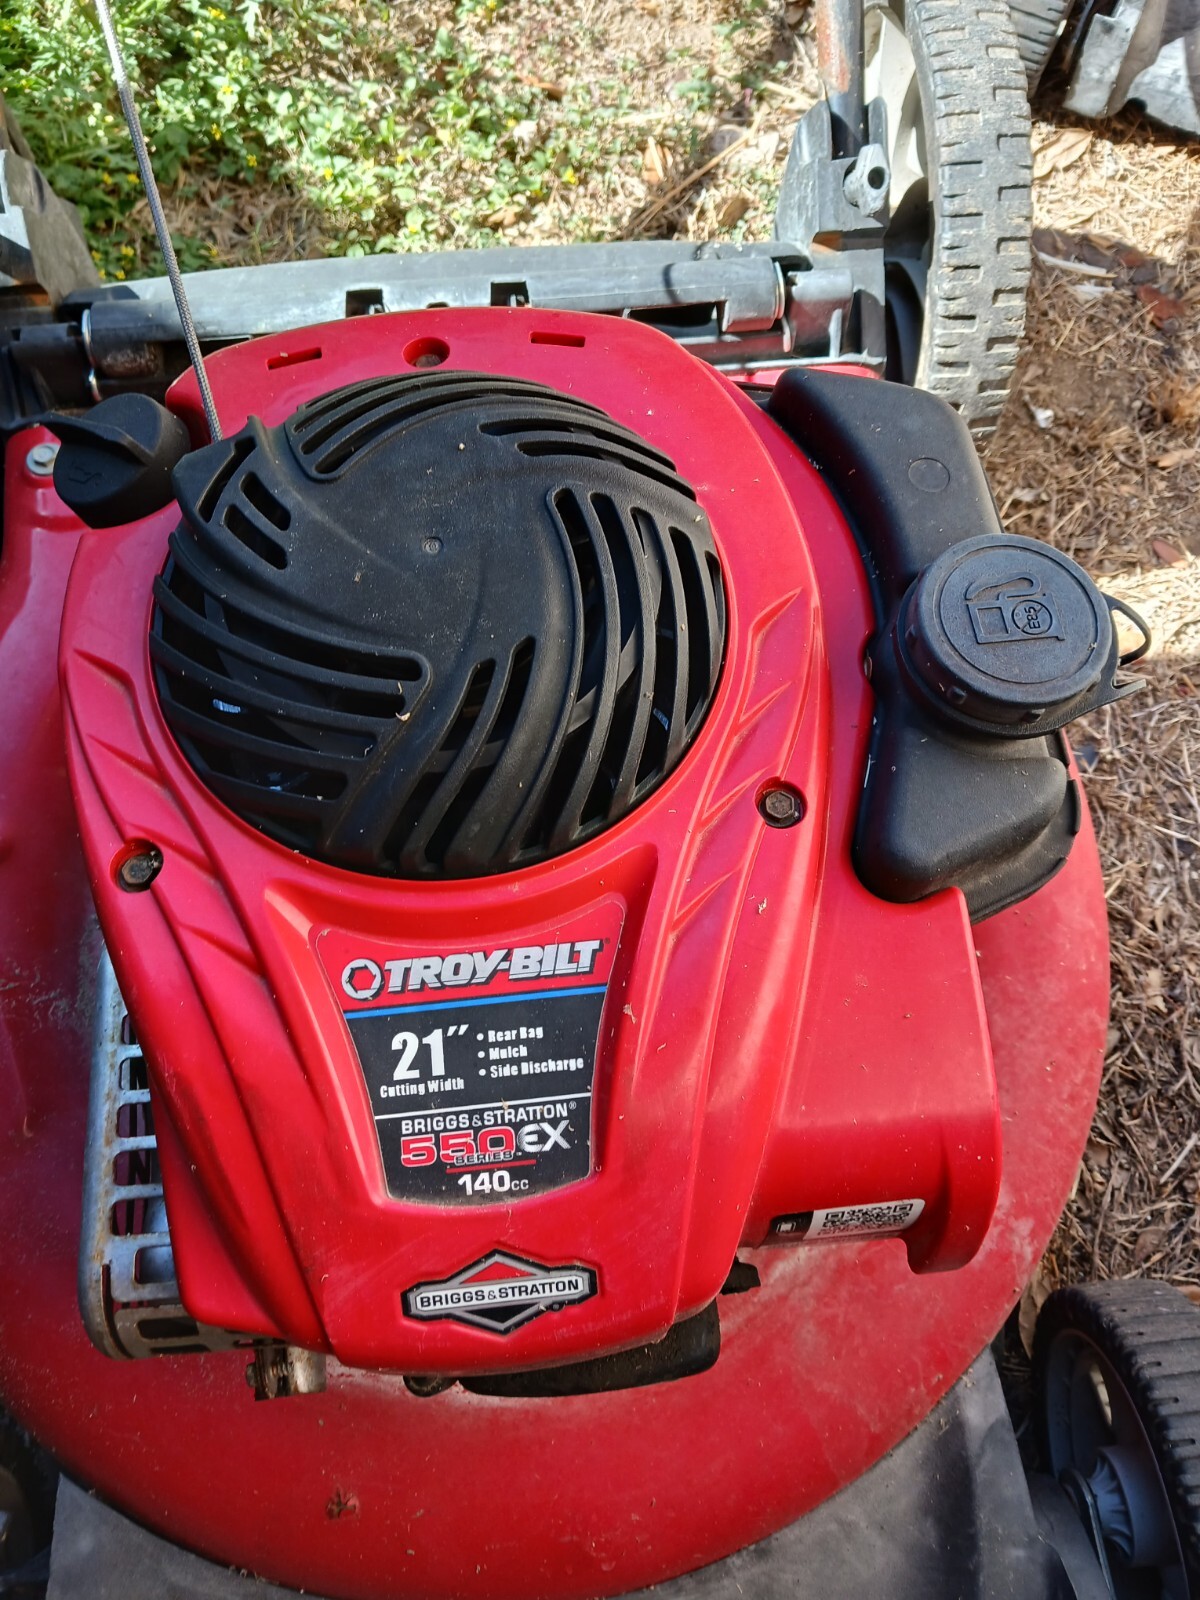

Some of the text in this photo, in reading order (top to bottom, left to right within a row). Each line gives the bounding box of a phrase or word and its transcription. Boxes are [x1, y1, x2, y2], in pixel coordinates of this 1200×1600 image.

[1023, 606, 1041, 629] E85
[384, 940, 602, 993] TROY-BILT
[488, 1027, 544, 1043] Rear Bag
[489, 1045, 528, 1060] Mulch
[490, 1056, 584, 1078] Side Discharge
[380, 1077, 465, 1098] Cutting Width
